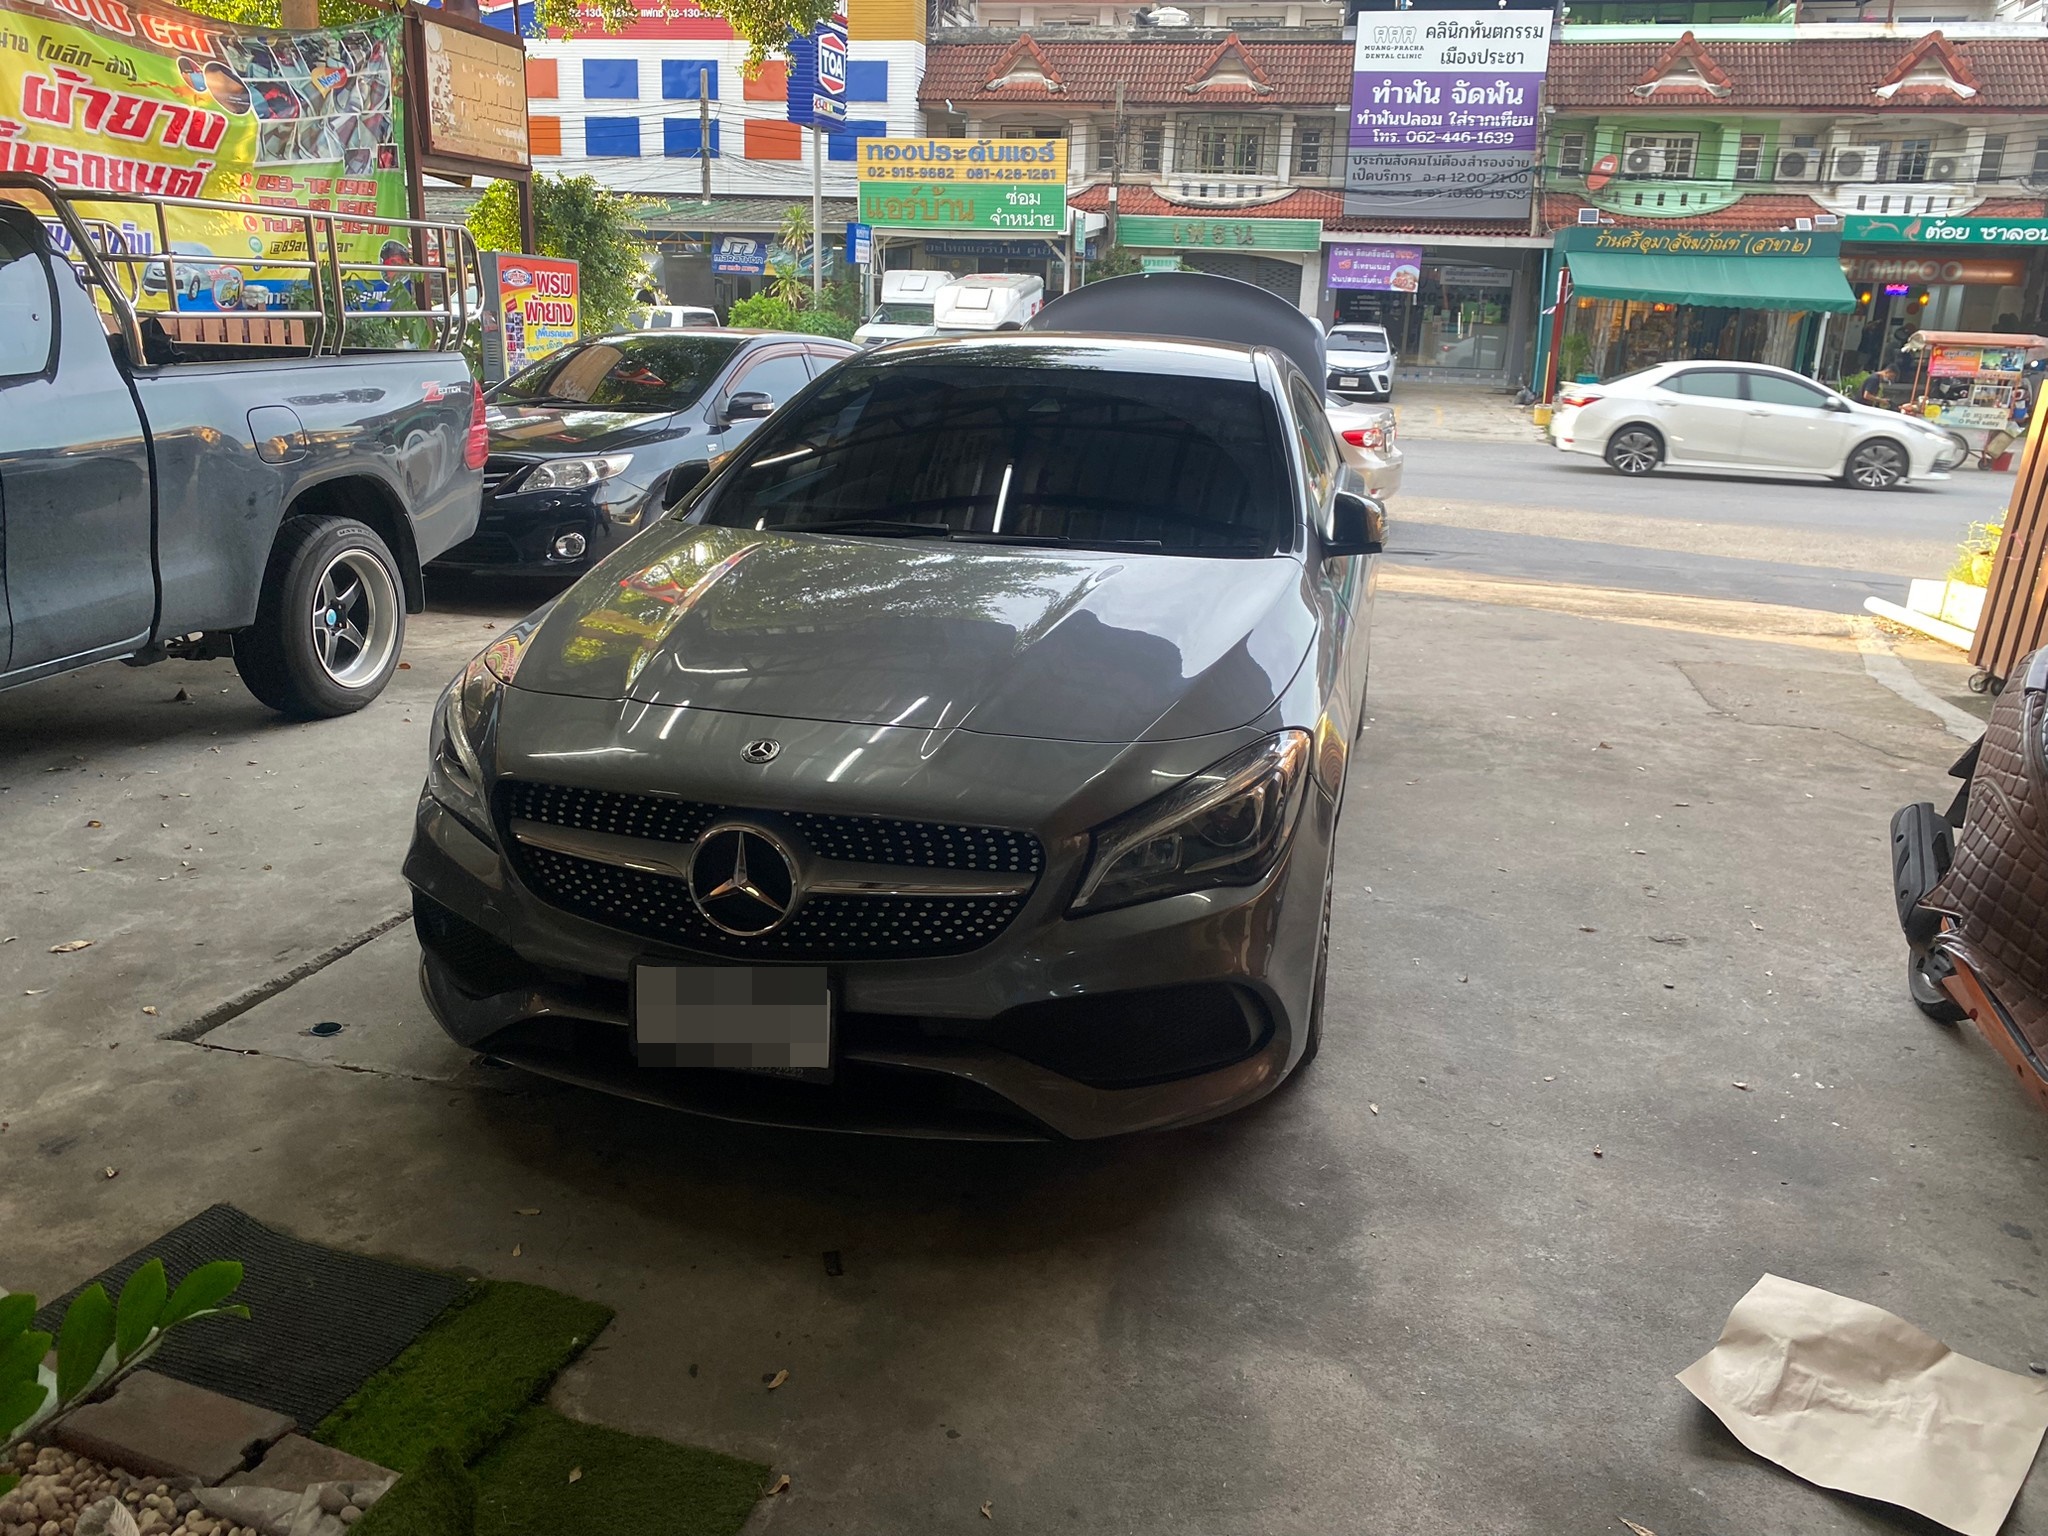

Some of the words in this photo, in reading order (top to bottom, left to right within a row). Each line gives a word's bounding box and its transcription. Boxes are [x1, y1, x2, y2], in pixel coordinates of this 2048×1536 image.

[1426, 21, 1544, 40] คลินิกทันตกรรม
[822, 49, 844, 79] TOA
[1440, 46, 1525, 65] เมืองประชา
[317, 70, 341, 88] New
[1372, 79, 1441, 105] ทำฟัน
[1451, 80, 1524, 105] จัดฟัน
[22, 66, 228, 152] ผ้ายาง
[1357, 109, 1443, 126] ทำฟันปลอม
[1449, 110, 1534, 127] ใส่รากเทียม
[1372, 129, 1400, 143] โทร.
[1405, 131, 1515, 144] 062-446-1639
[866, 140, 1056, 163] ทองประดับแอร์
[1352, 168, 1412, 182] เปิดบริการ
[866, 186, 976, 221] แอร์บ้าน
[1005, 186, 1041, 206] ซ่อม
[989, 208, 1055, 227] จำหน่าย
[1925, 219, 1971, 240] ต้อย
[535, 272, 573, 297] พรม
